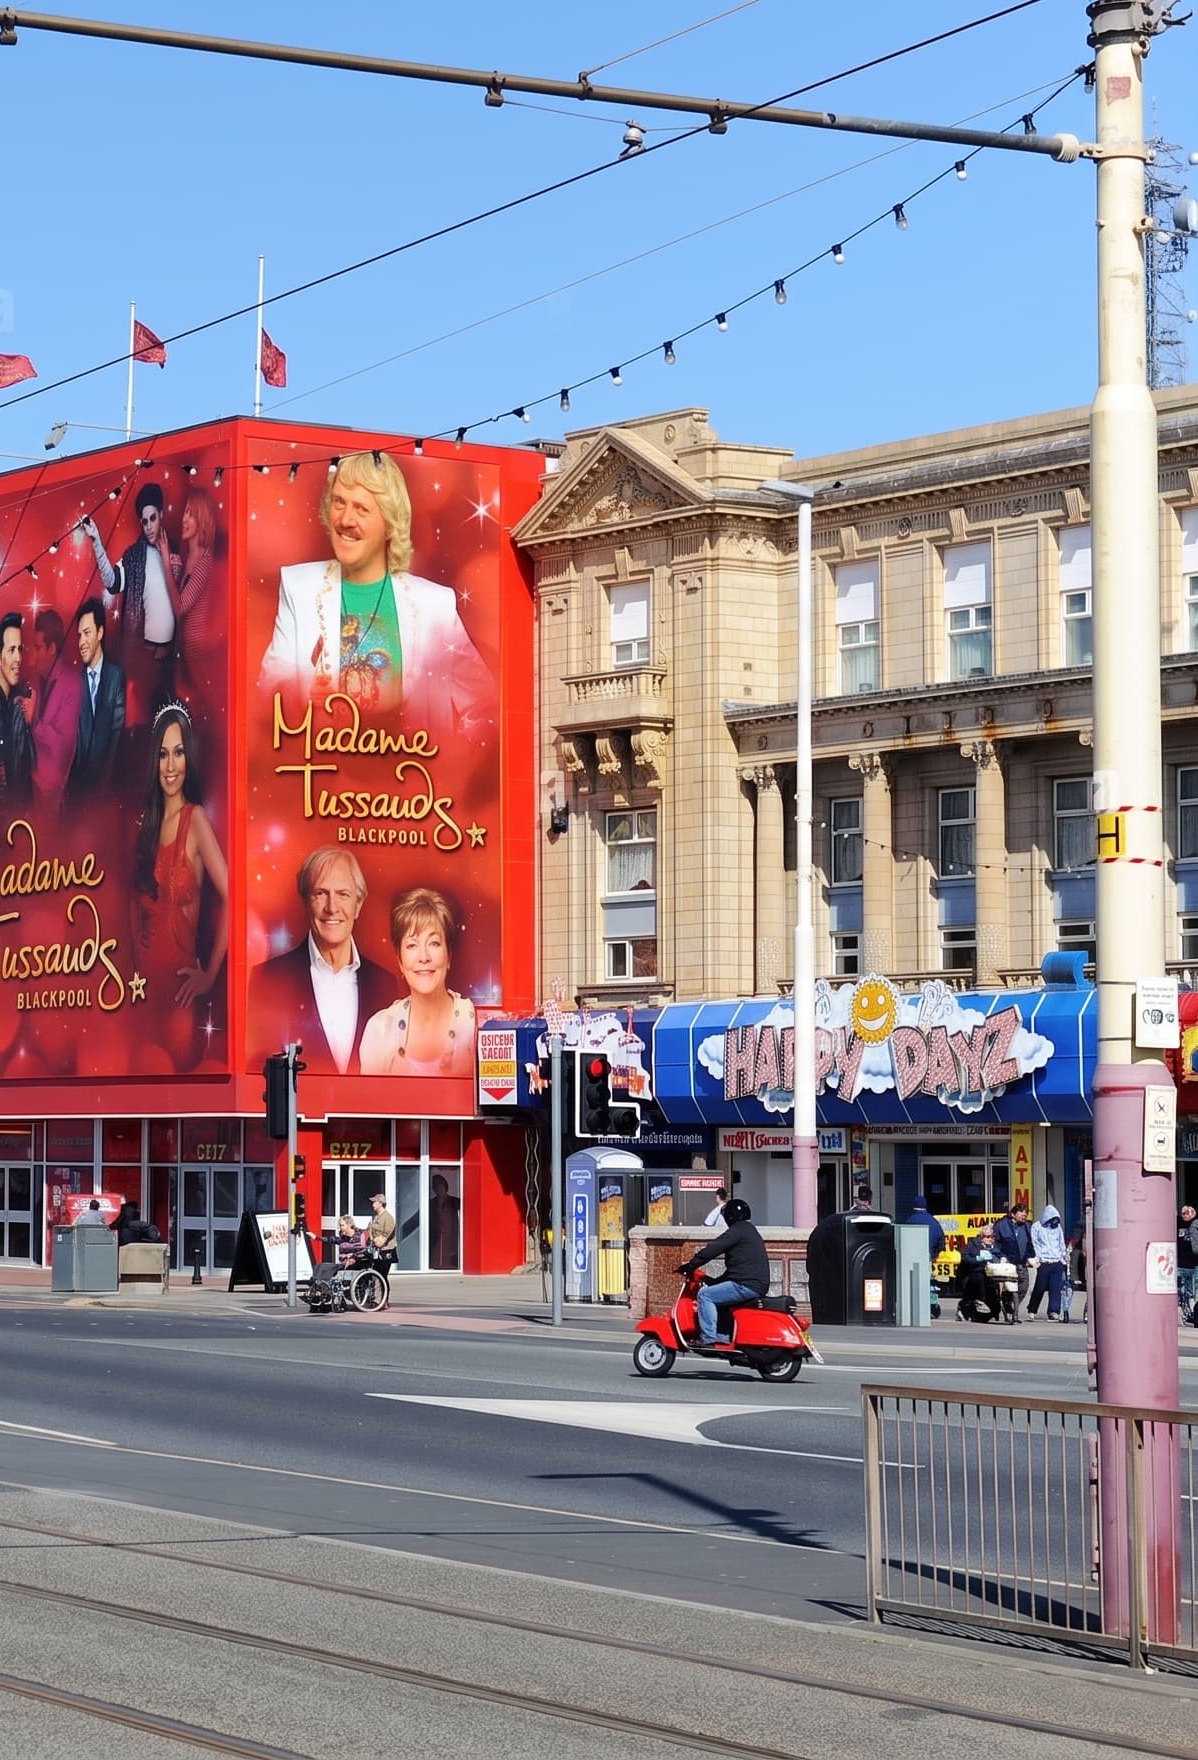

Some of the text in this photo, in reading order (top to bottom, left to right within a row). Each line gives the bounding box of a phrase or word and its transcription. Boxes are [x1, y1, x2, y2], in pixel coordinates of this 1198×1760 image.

[273, 692, 438, 759] Madame
[275, 761, 462, 850] Tussauds
[338, 827, 427, 846] BLACKPOOL
[17, 989, 92, 1010] BLACKPOOL
[891, 1004, 1022, 1101] DAYZ
[1015, 1145, 1029, 1208] ATM
